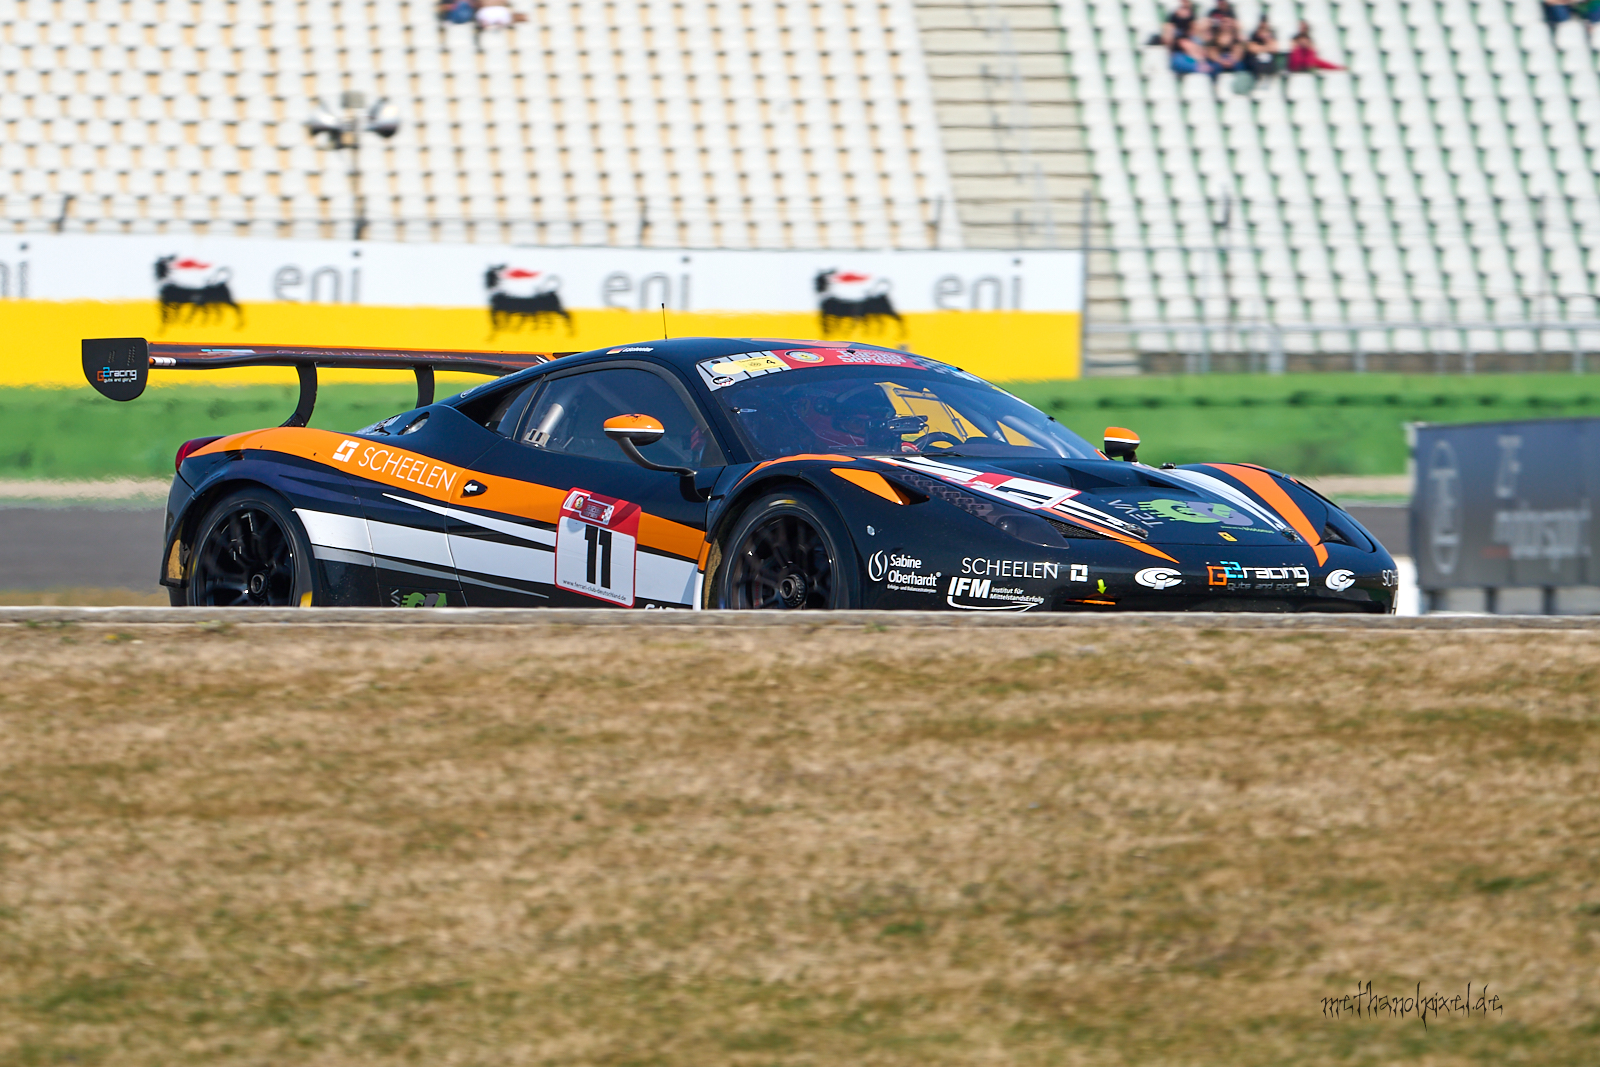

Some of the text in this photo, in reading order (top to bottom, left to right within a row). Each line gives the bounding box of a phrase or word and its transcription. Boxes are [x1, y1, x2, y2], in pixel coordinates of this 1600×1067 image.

[273, 249, 361, 303] eni
[602, 256, 690, 310] eni
[933, 258, 1022, 310] eni
[358, 446, 457, 492] SCHEELEN
[584, 524, 613, 590] 11
[889, 553, 922, 569] Sabine
[960, 556, 1058, 580] SCHEELEN
[947, 576, 992, 599] IFM
[991, 586, 1013, 595] Institut
